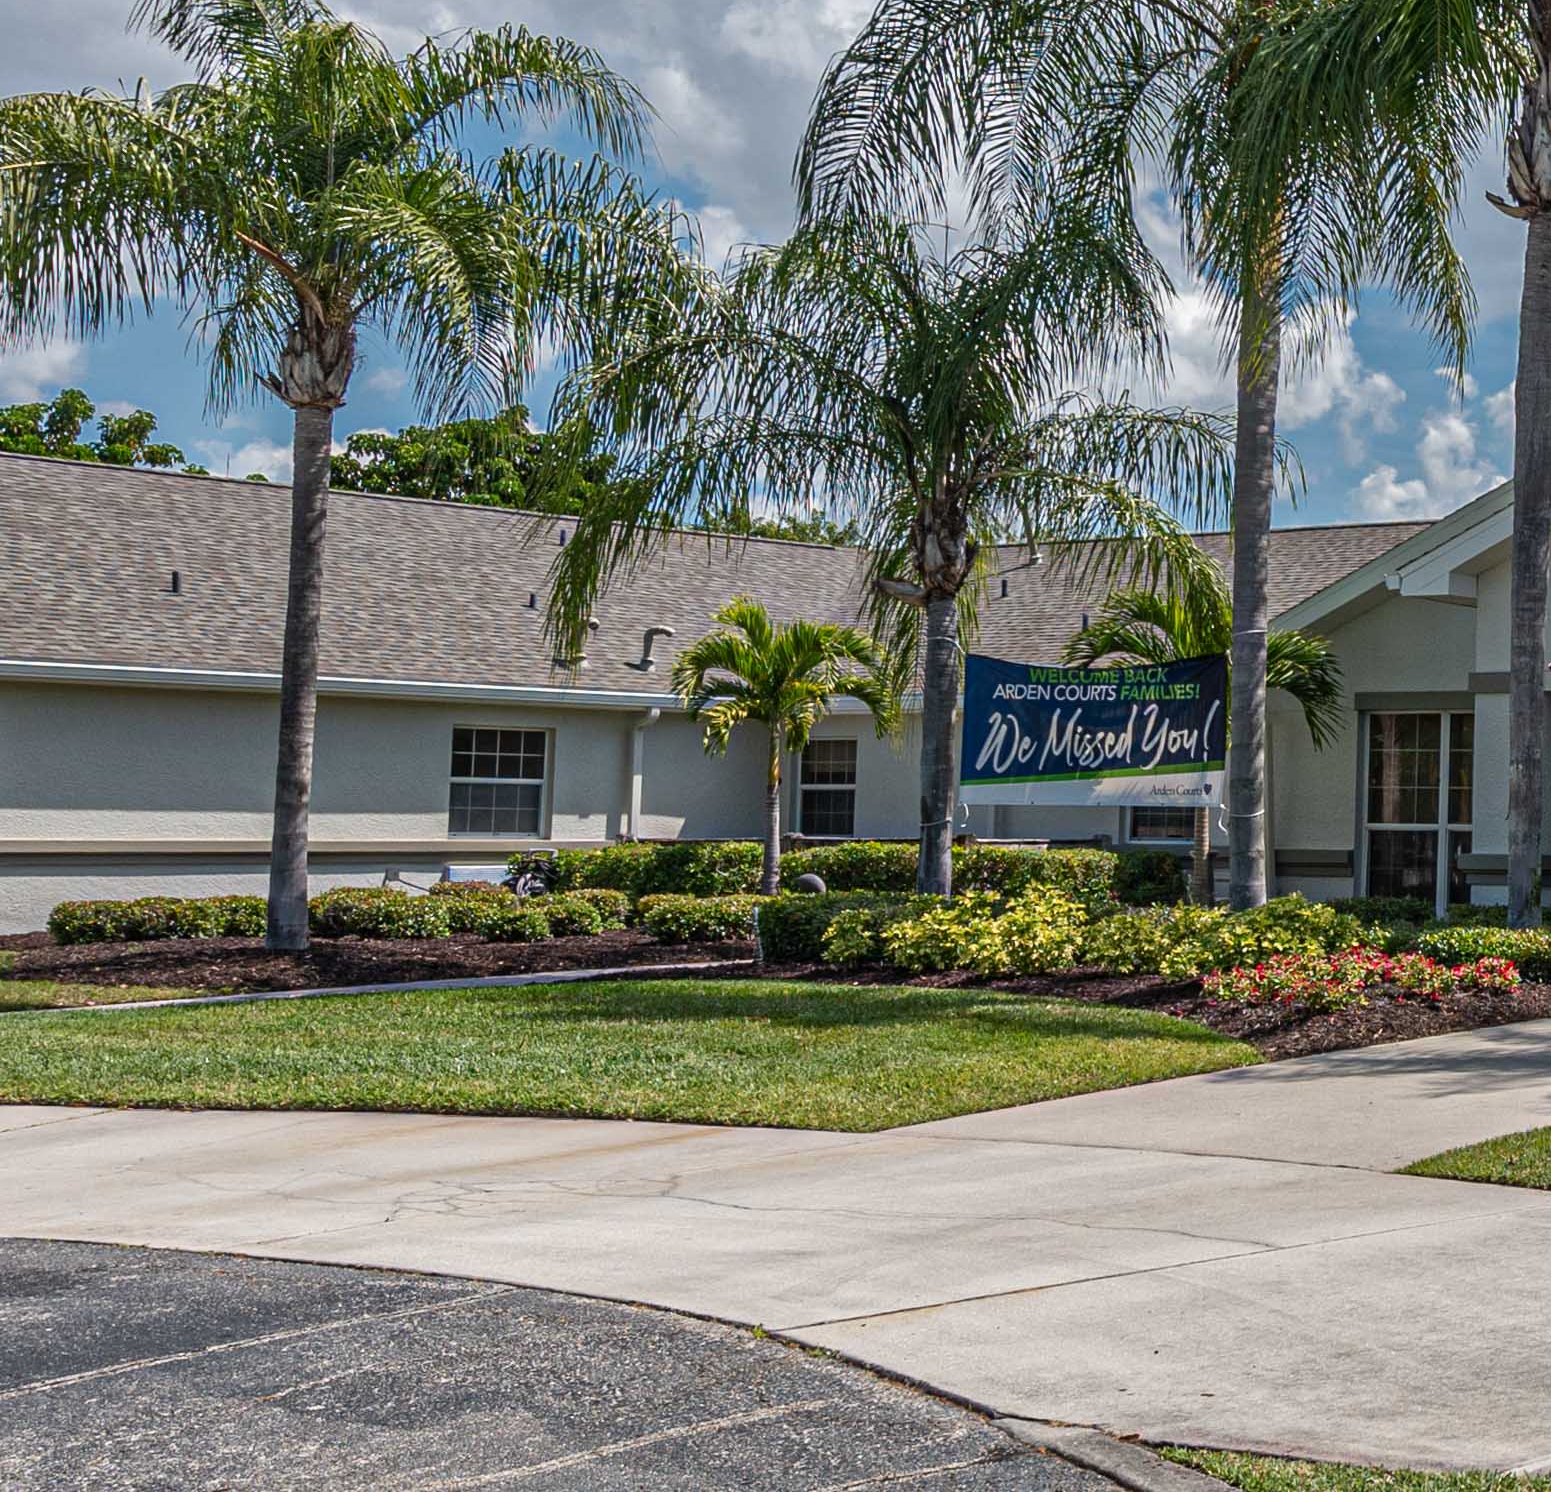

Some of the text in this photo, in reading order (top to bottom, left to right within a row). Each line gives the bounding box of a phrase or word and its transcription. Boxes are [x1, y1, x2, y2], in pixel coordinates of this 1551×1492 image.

[1029, 667, 1168, 684] WELCOME BACK
[992, 683, 1201, 701] ARDEN COURTS FAMILIES!
[975, 699, 1220, 774] We Missed You!
[1150, 783, 1176, 796] Arden
